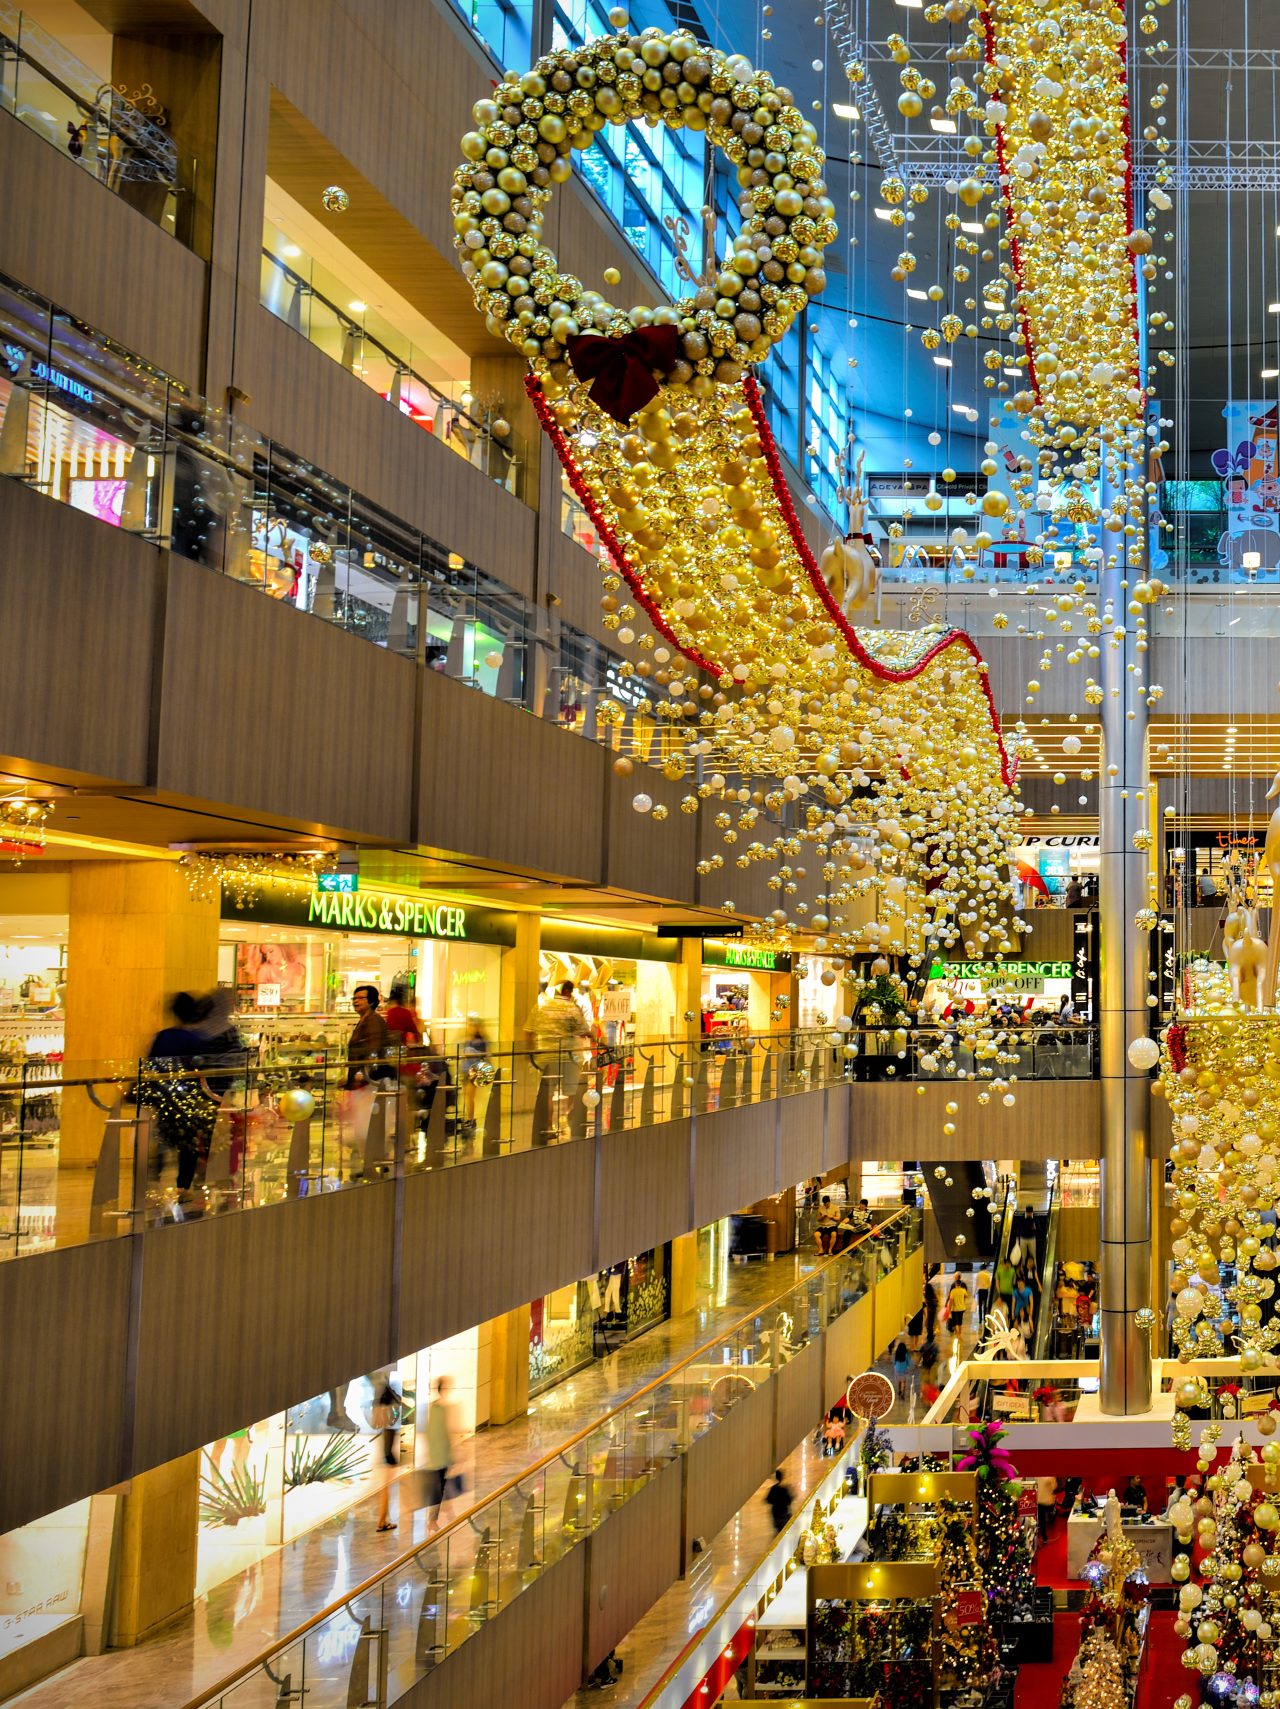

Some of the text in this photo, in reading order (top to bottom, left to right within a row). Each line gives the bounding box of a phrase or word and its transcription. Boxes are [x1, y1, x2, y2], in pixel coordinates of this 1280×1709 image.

[1018, 836, 1041, 847] IP
[1216, 832, 1260, 847] times
[1014, 977, 1042, 990] OFF
[959, 1602, 980, 1616] 50%
